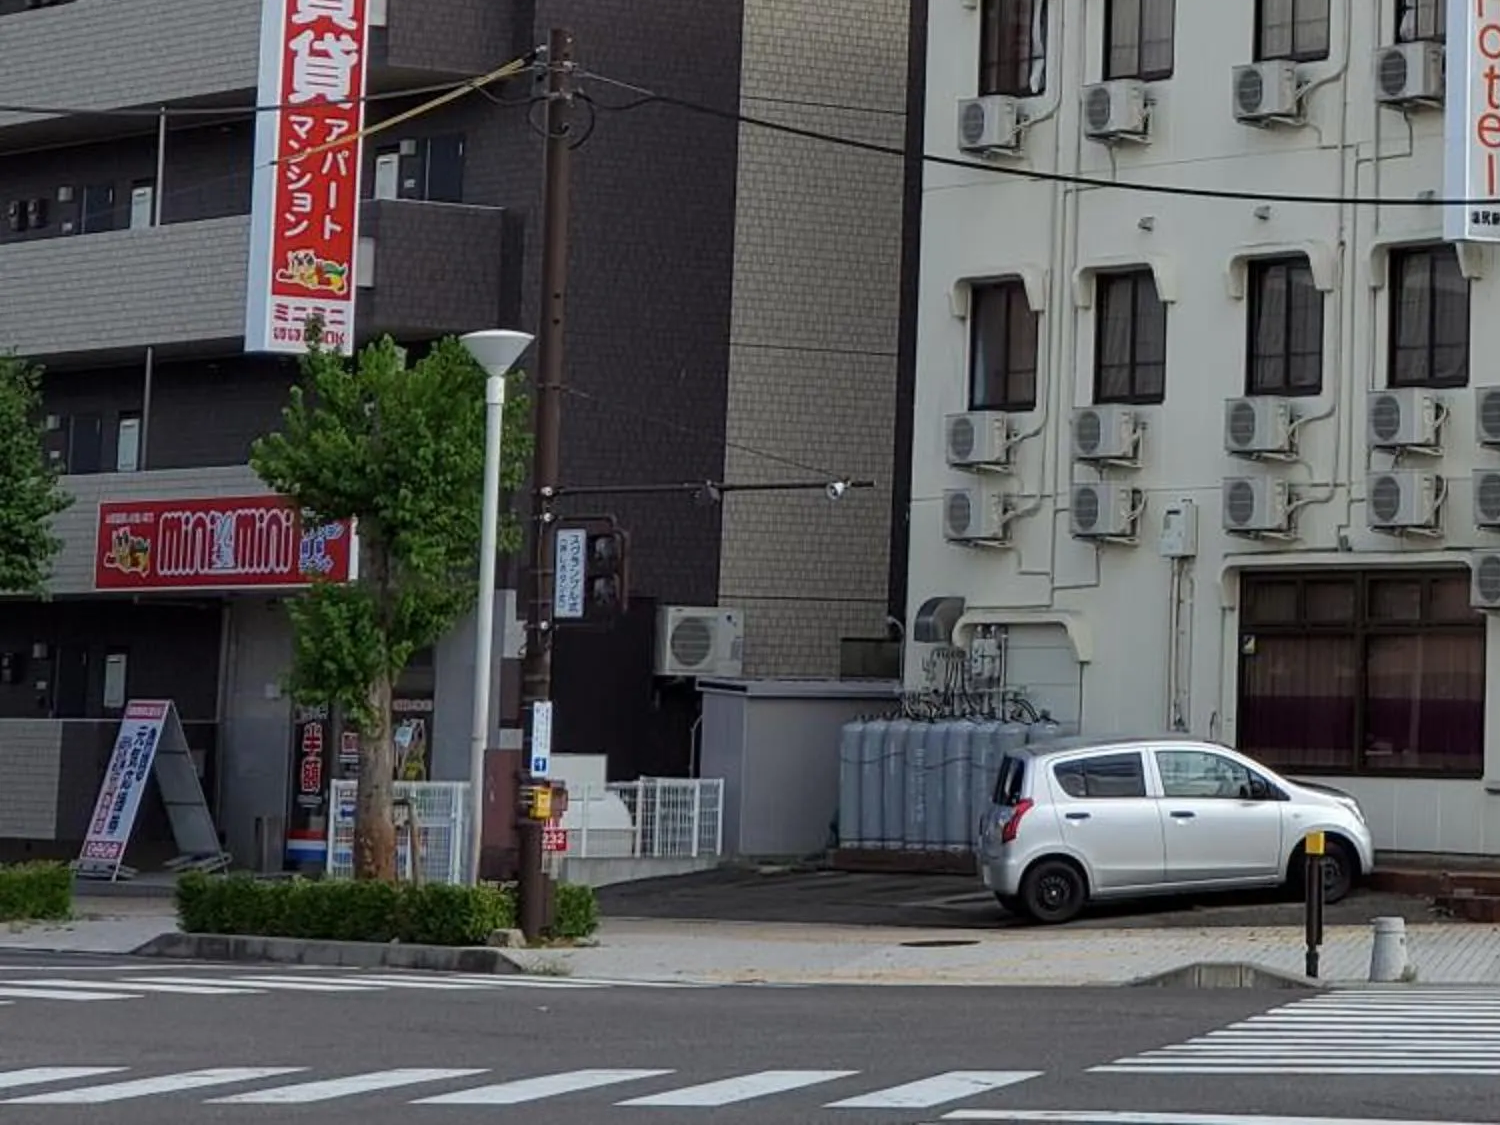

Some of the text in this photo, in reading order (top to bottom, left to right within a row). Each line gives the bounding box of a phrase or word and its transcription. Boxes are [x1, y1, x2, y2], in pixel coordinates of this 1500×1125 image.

[284, 114, 315, 240] マンション
[321, 117, 351, 242] アパート
